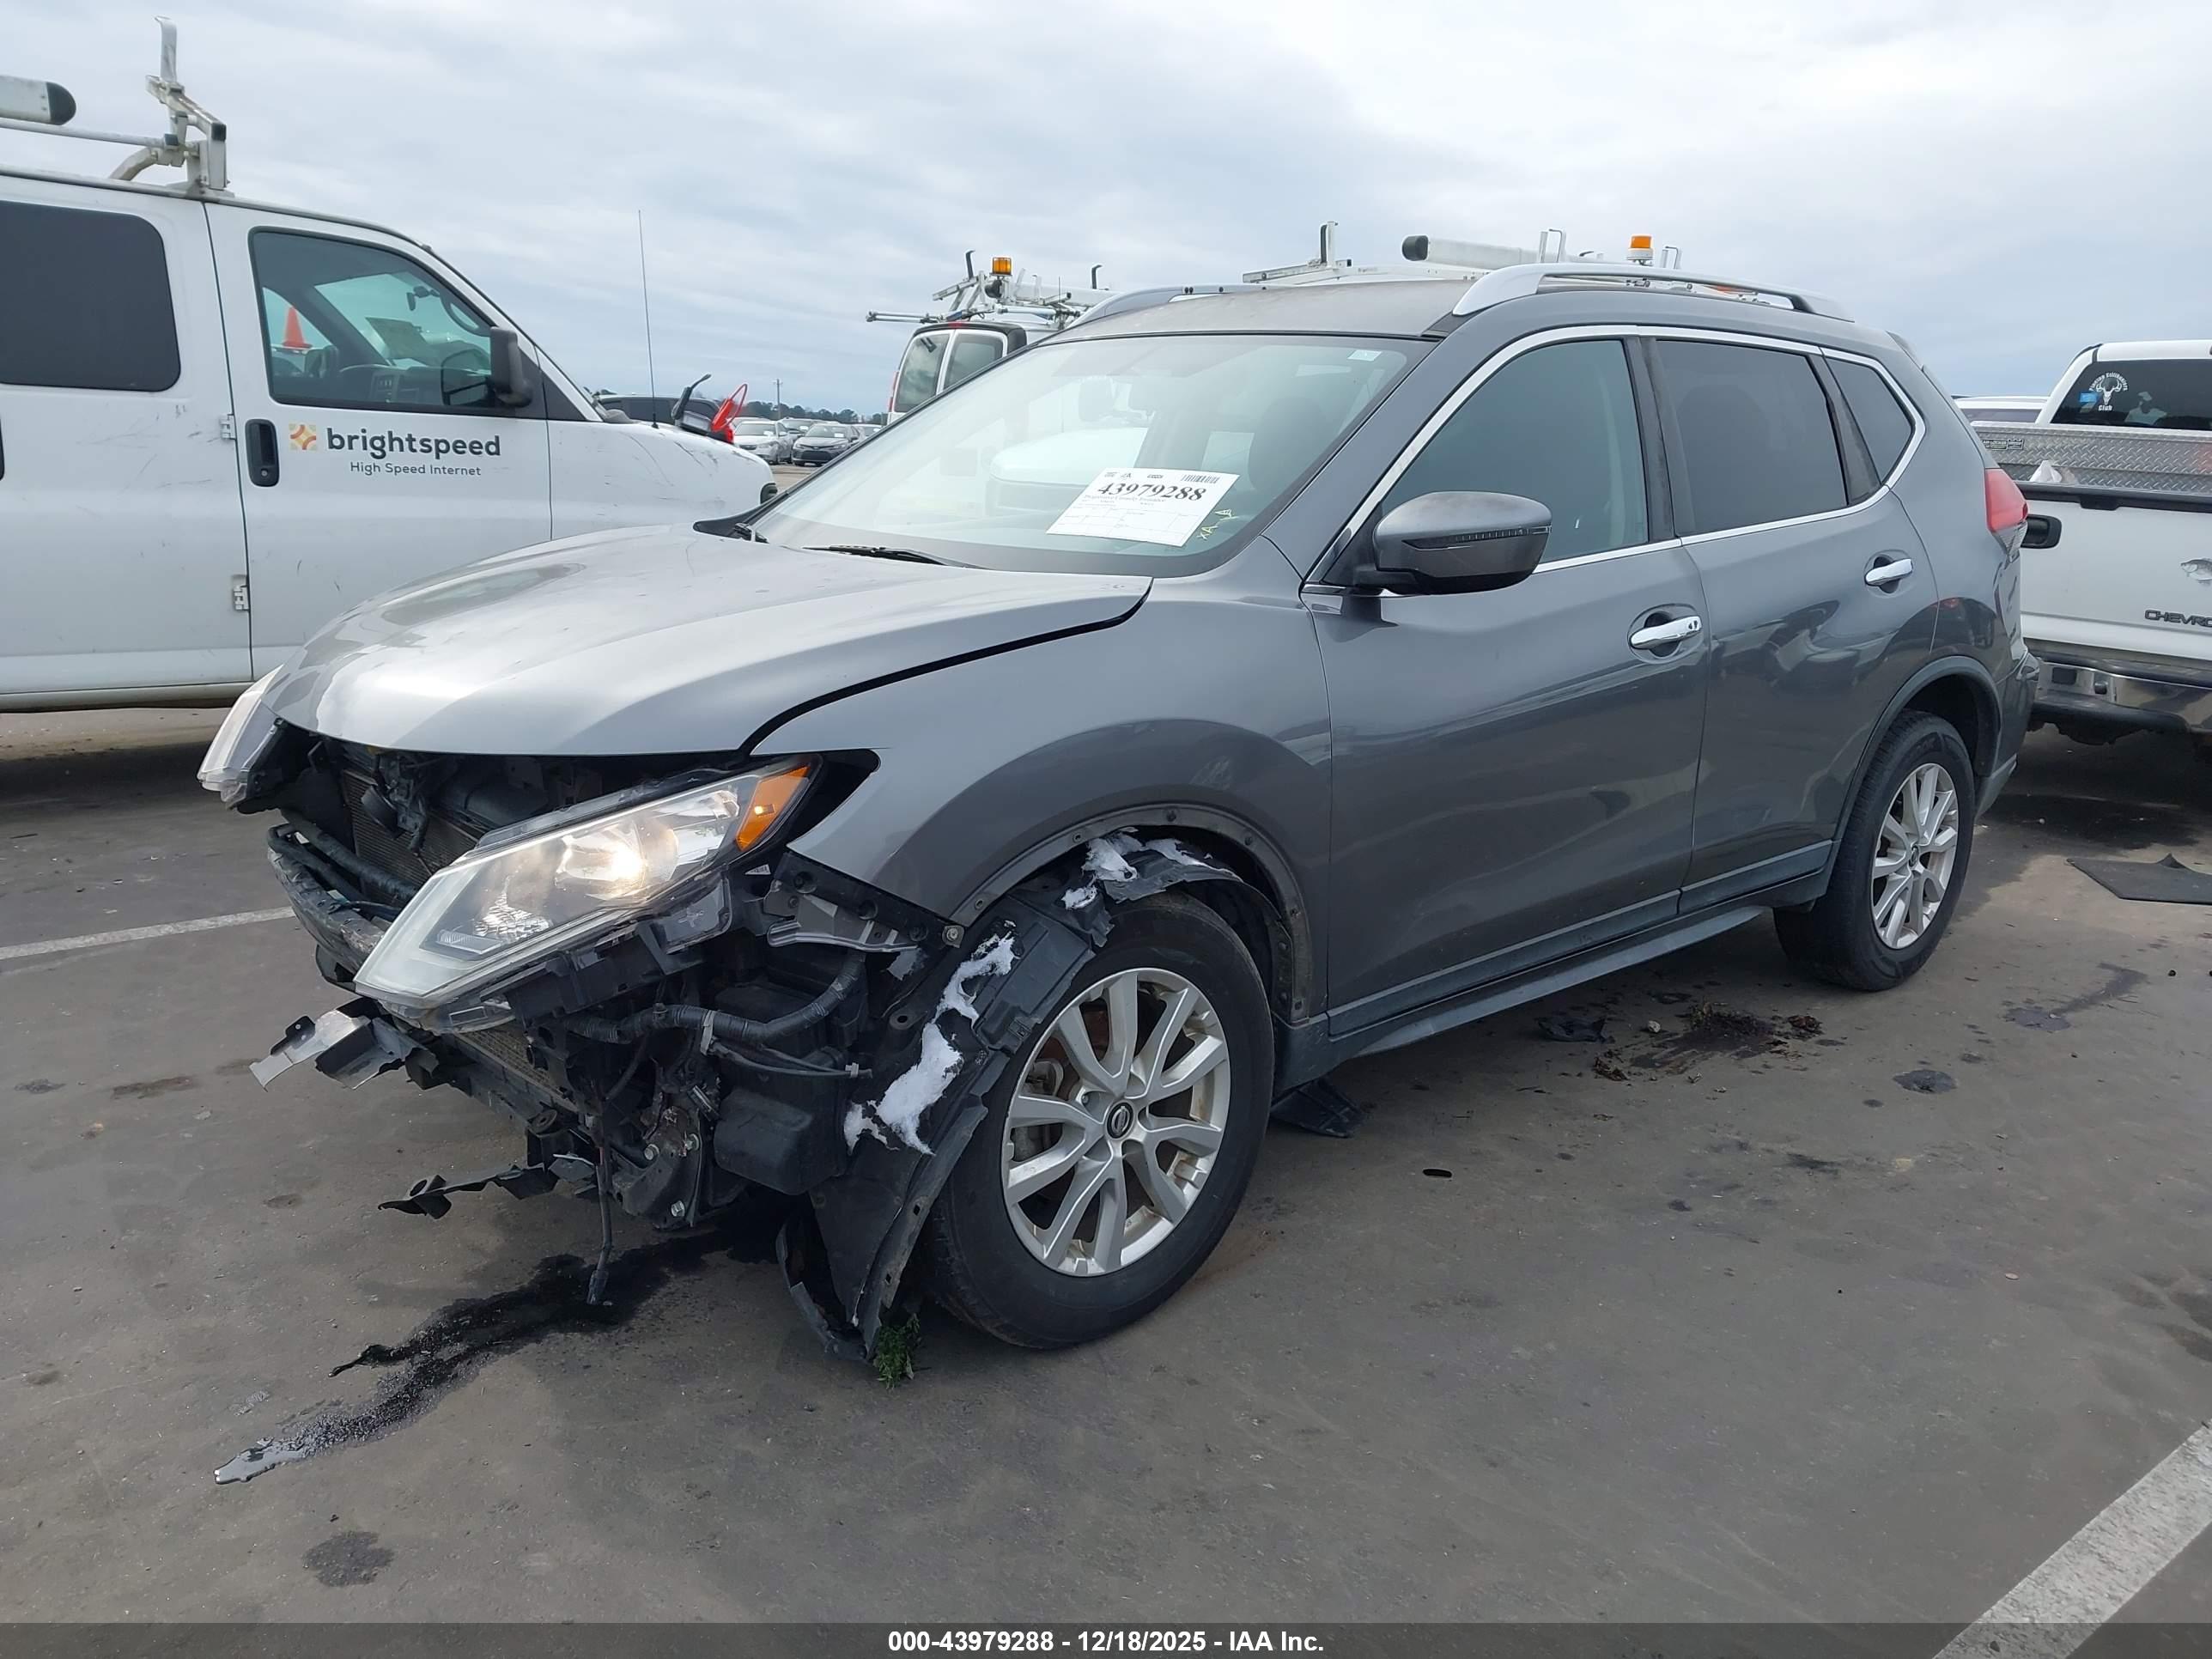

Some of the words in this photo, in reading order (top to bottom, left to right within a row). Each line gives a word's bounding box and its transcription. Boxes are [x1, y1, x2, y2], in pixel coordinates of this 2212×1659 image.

[326, 428, 501, 459] brightspeed
[350, 462, 380, 476] High
[385, 463, 426, 476] Speed
[430, 465, 482, 476] Internet
[1097, 481, 1206, 501] 43979288
